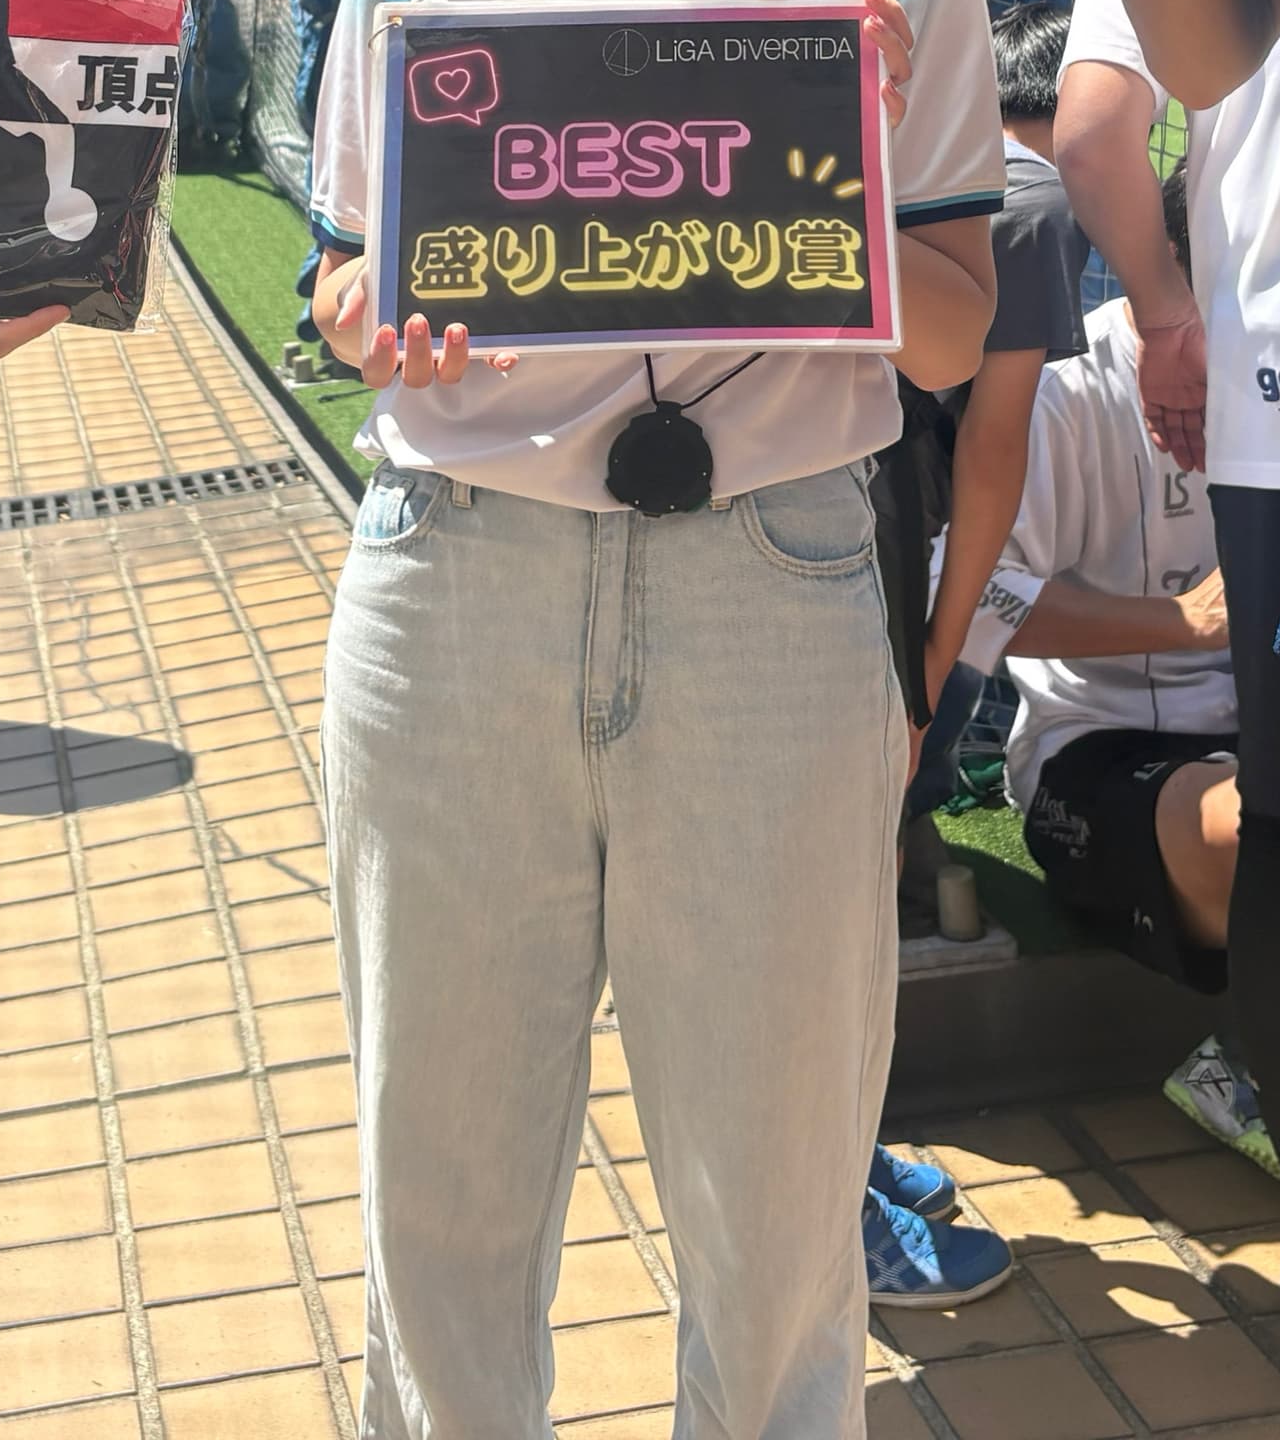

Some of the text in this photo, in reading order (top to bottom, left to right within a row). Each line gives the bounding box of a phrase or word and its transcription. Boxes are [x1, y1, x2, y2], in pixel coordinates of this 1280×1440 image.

[75, 54, 179, 116] 頂点
[494, 120, 751, 200] BEST
[410, 218, 866, 300] 盛り上がり賞
